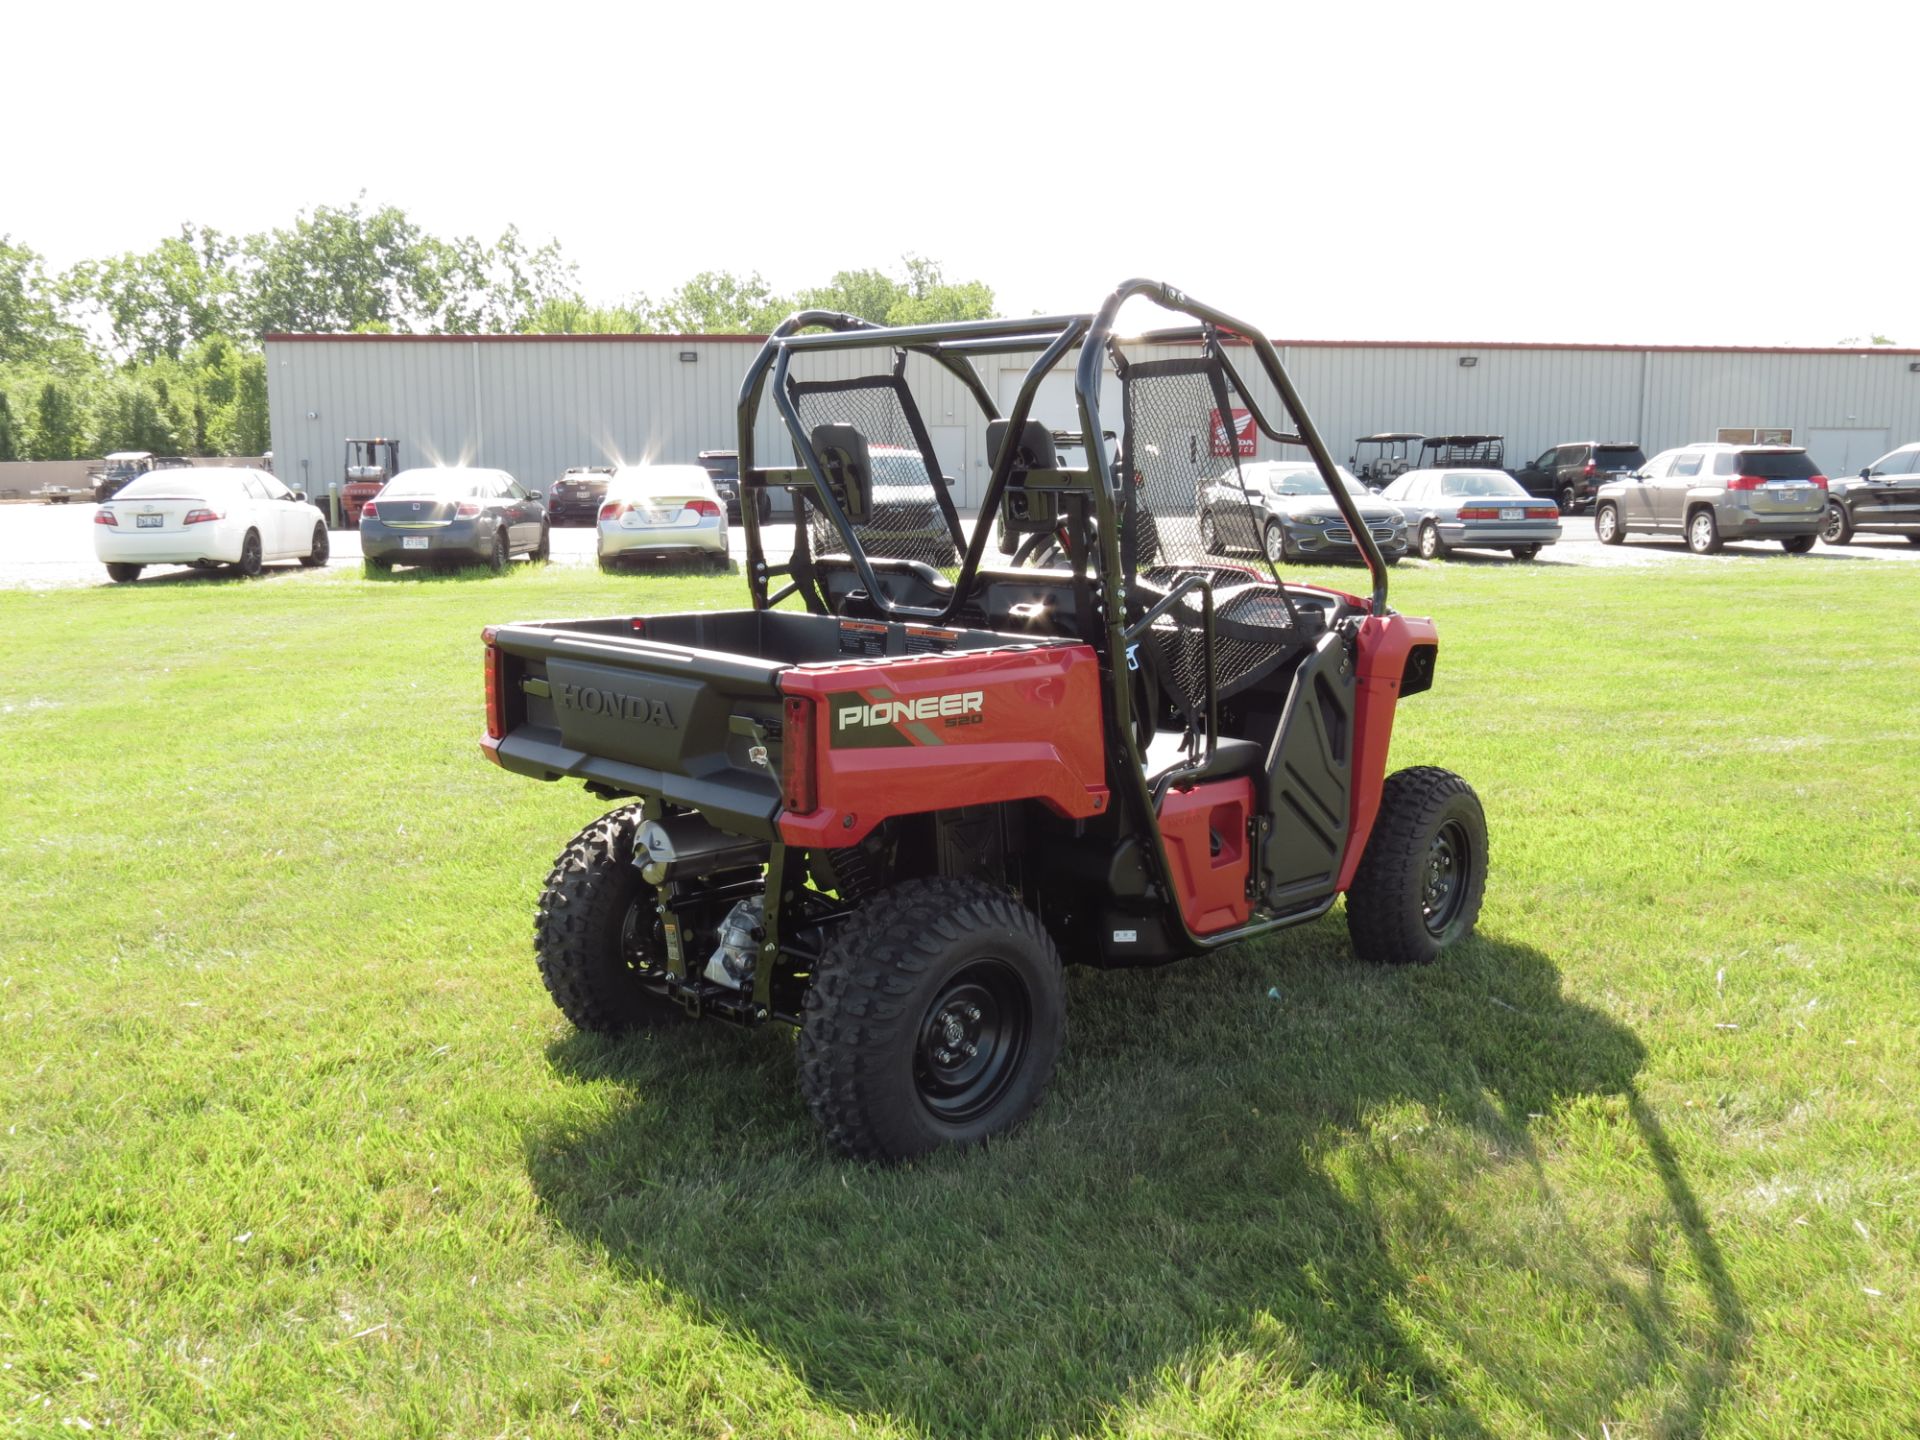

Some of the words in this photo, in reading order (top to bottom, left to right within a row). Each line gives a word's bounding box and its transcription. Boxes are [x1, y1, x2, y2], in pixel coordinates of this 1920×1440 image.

[560, 683, 678, 729] HONDA
[839, 691, 984, 730] PIONEER
[944, 714, 983, 728] 520
